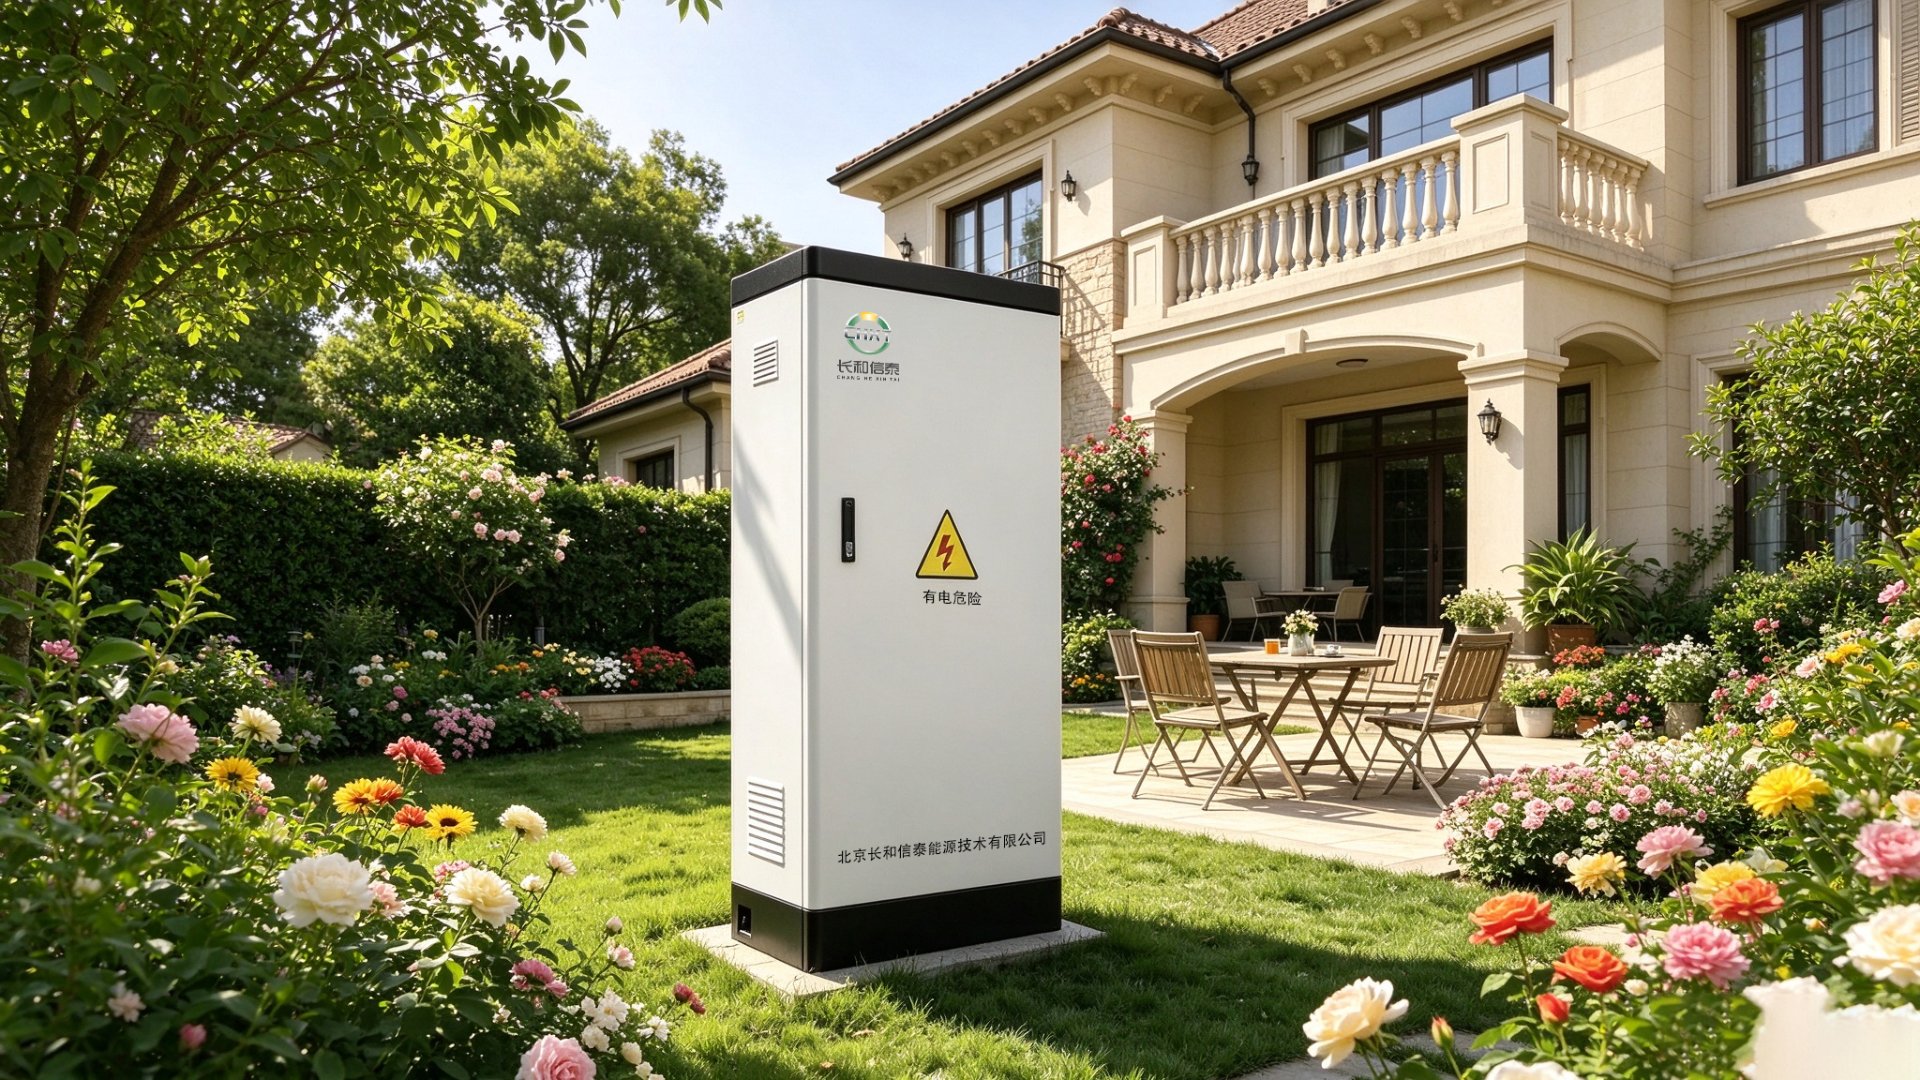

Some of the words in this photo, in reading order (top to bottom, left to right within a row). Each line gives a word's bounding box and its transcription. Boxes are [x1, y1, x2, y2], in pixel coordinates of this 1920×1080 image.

[837, 359, 900, 375] 长和信泰
[923, 589, 982, 606] 有电危险
[837, 831, 1046, 865] 北京长和信泰能源技术有限公司
